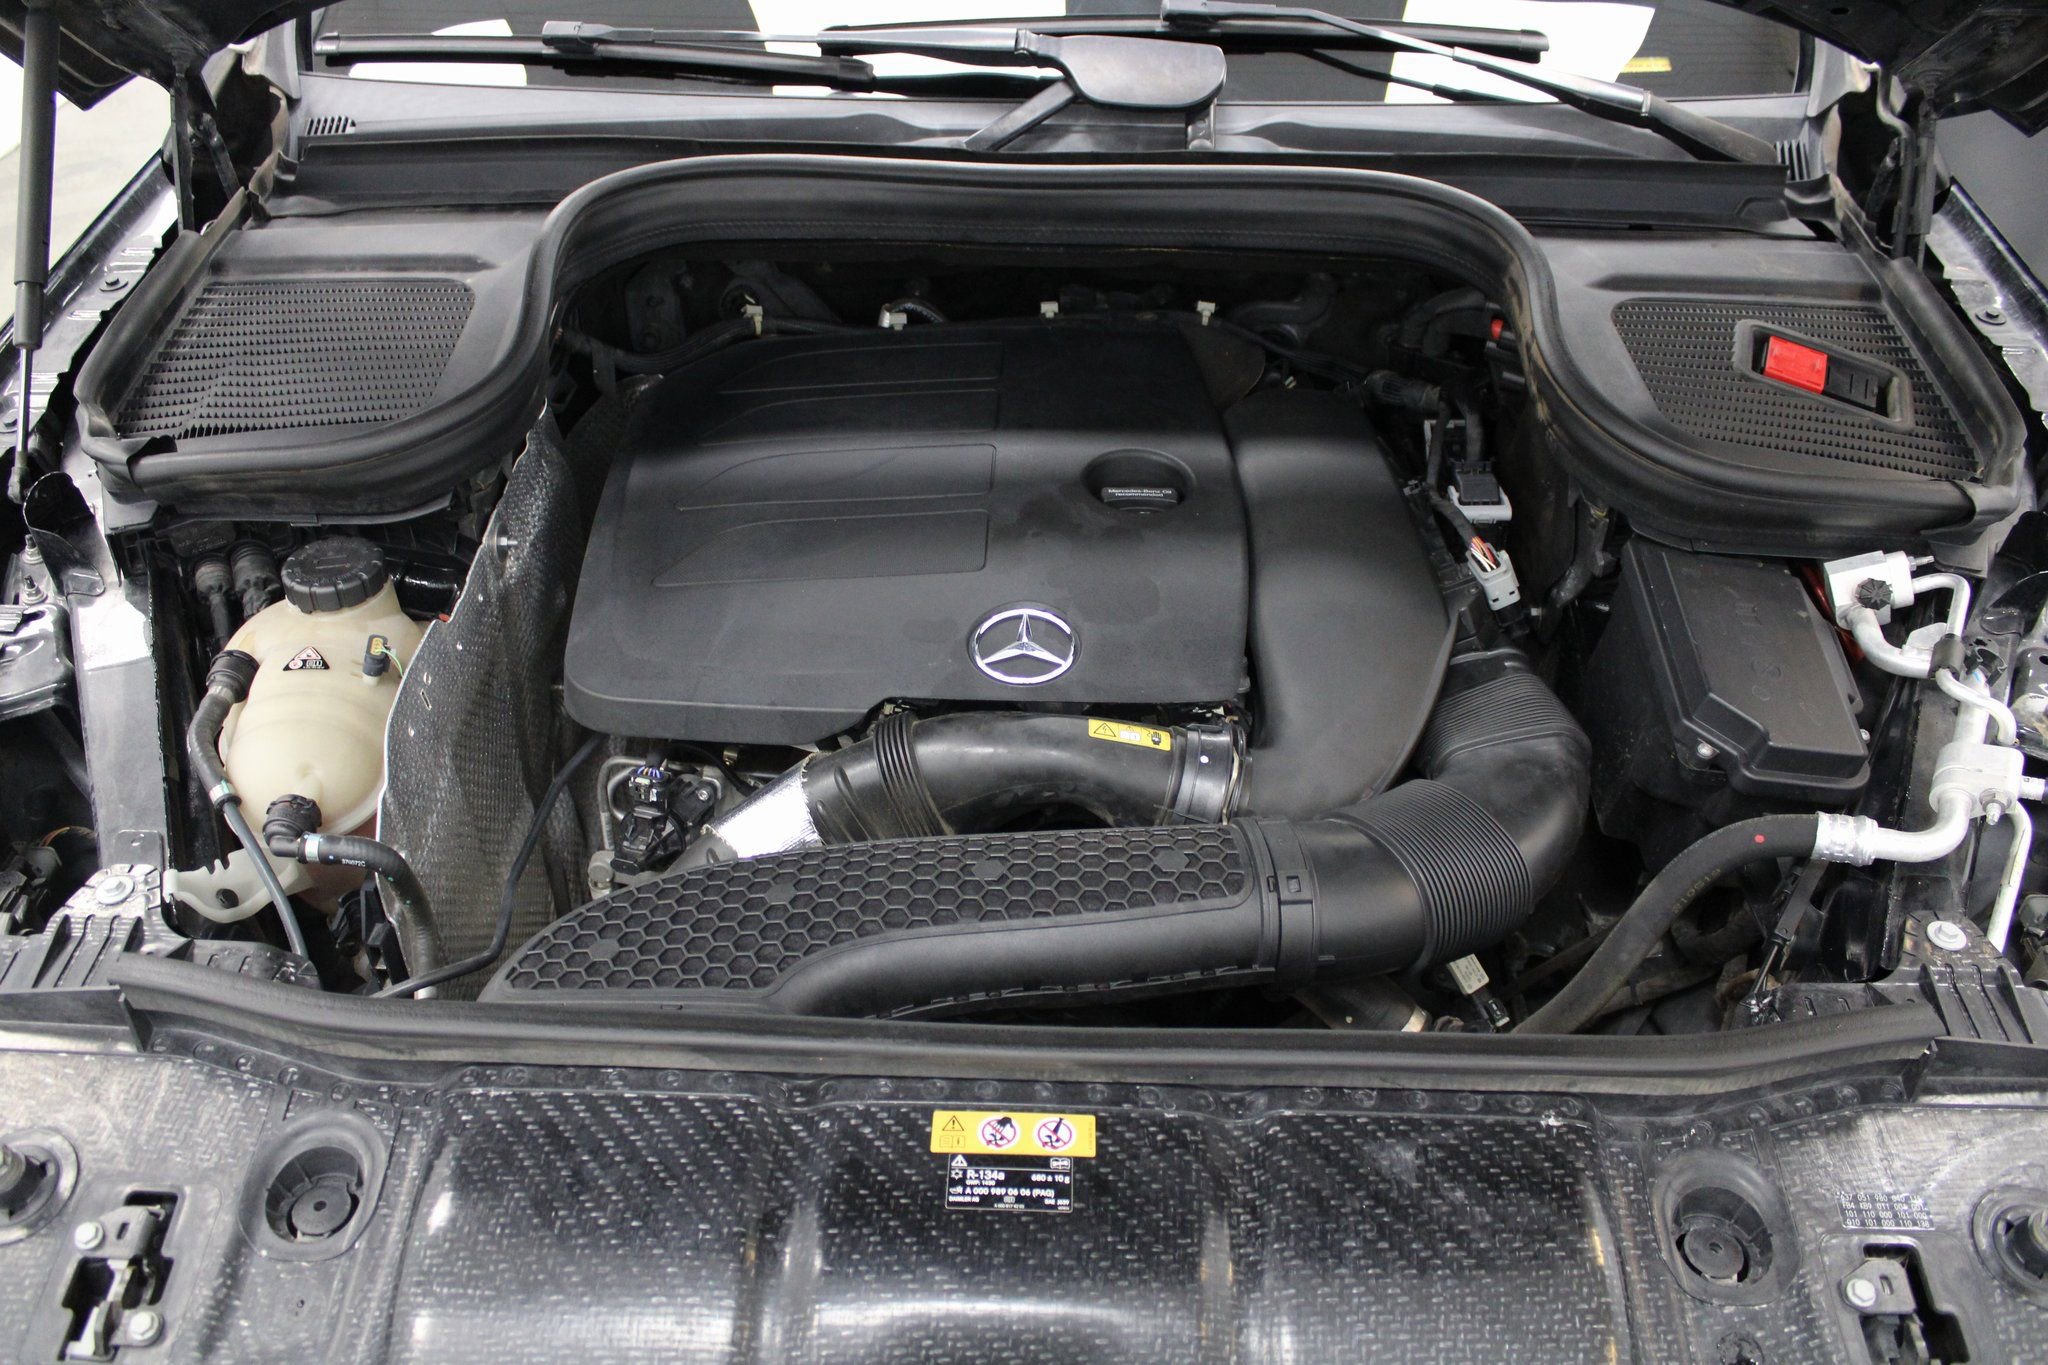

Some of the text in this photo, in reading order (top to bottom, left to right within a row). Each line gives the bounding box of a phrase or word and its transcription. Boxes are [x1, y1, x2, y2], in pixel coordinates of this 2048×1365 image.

[966, 1169, 1005, 1180] R-134a
[1054, 1174, 1064, 1183] 10
[965, 1187, 1055, 1199] A 000 989 06 06 (PAG)
[1845, 1210, 1858, 1218] 101
[1862, 1210, 1876, 1218] 110
[1879, 1211, 1893, 1219] 000
[1897, 1211, 1910, 1219] 101
[1864, 1219, 1877, 1227] 101
[1881, 1219, 1895, 1227] 000
